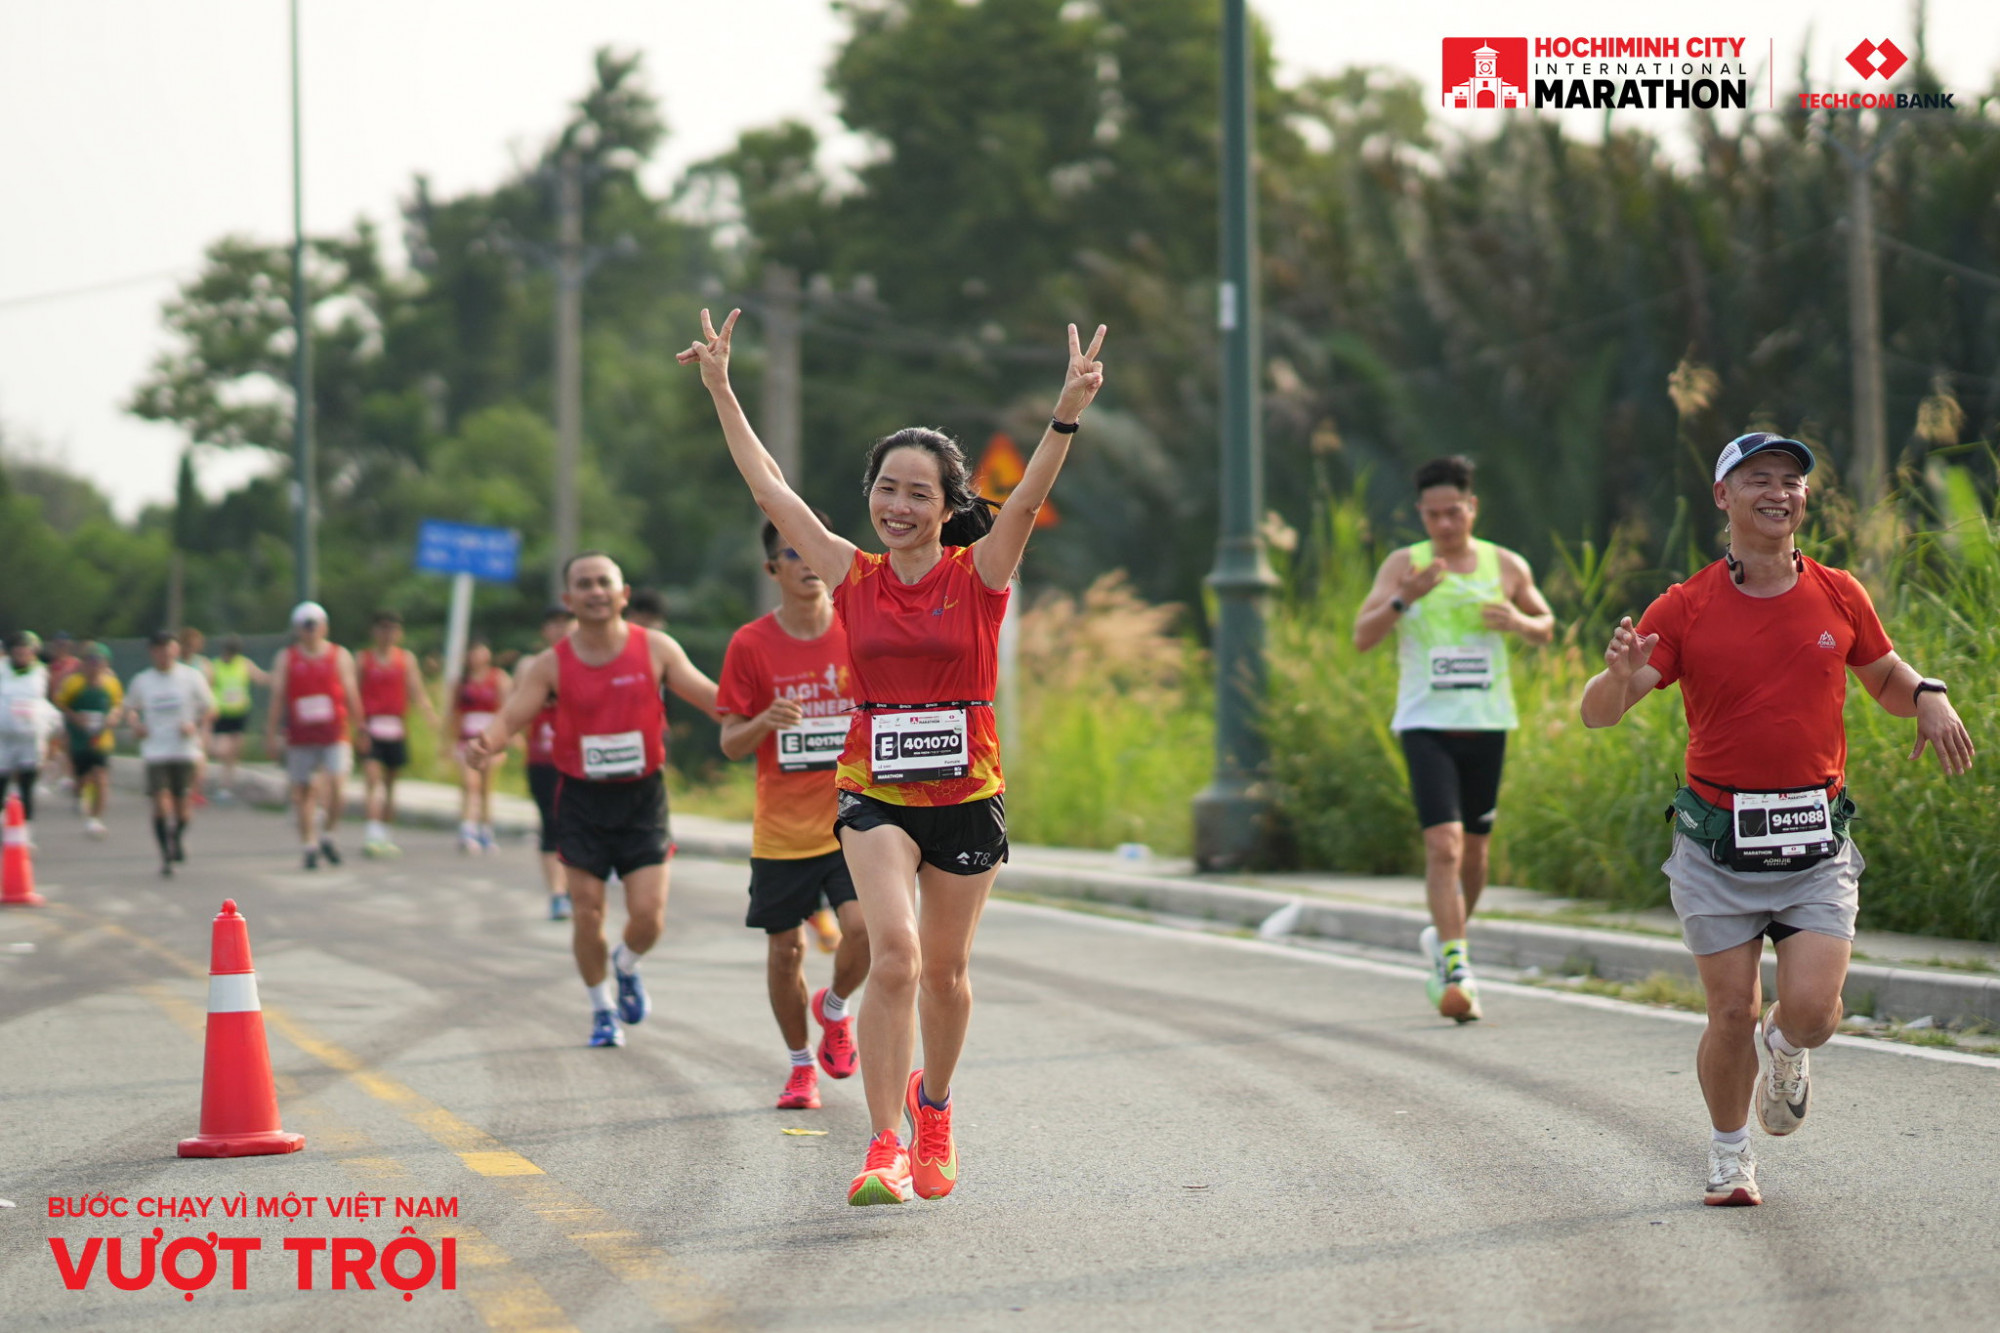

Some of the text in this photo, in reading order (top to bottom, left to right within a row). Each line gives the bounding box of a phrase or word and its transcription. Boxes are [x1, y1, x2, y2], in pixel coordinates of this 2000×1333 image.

[785, 735, 799, 752] E
[881, 736, 893, 757] E
[903, 735, 960, 750] 401070
[1772, 809, 1825, 827] 941088
[973, 851, 990, 866] T8
